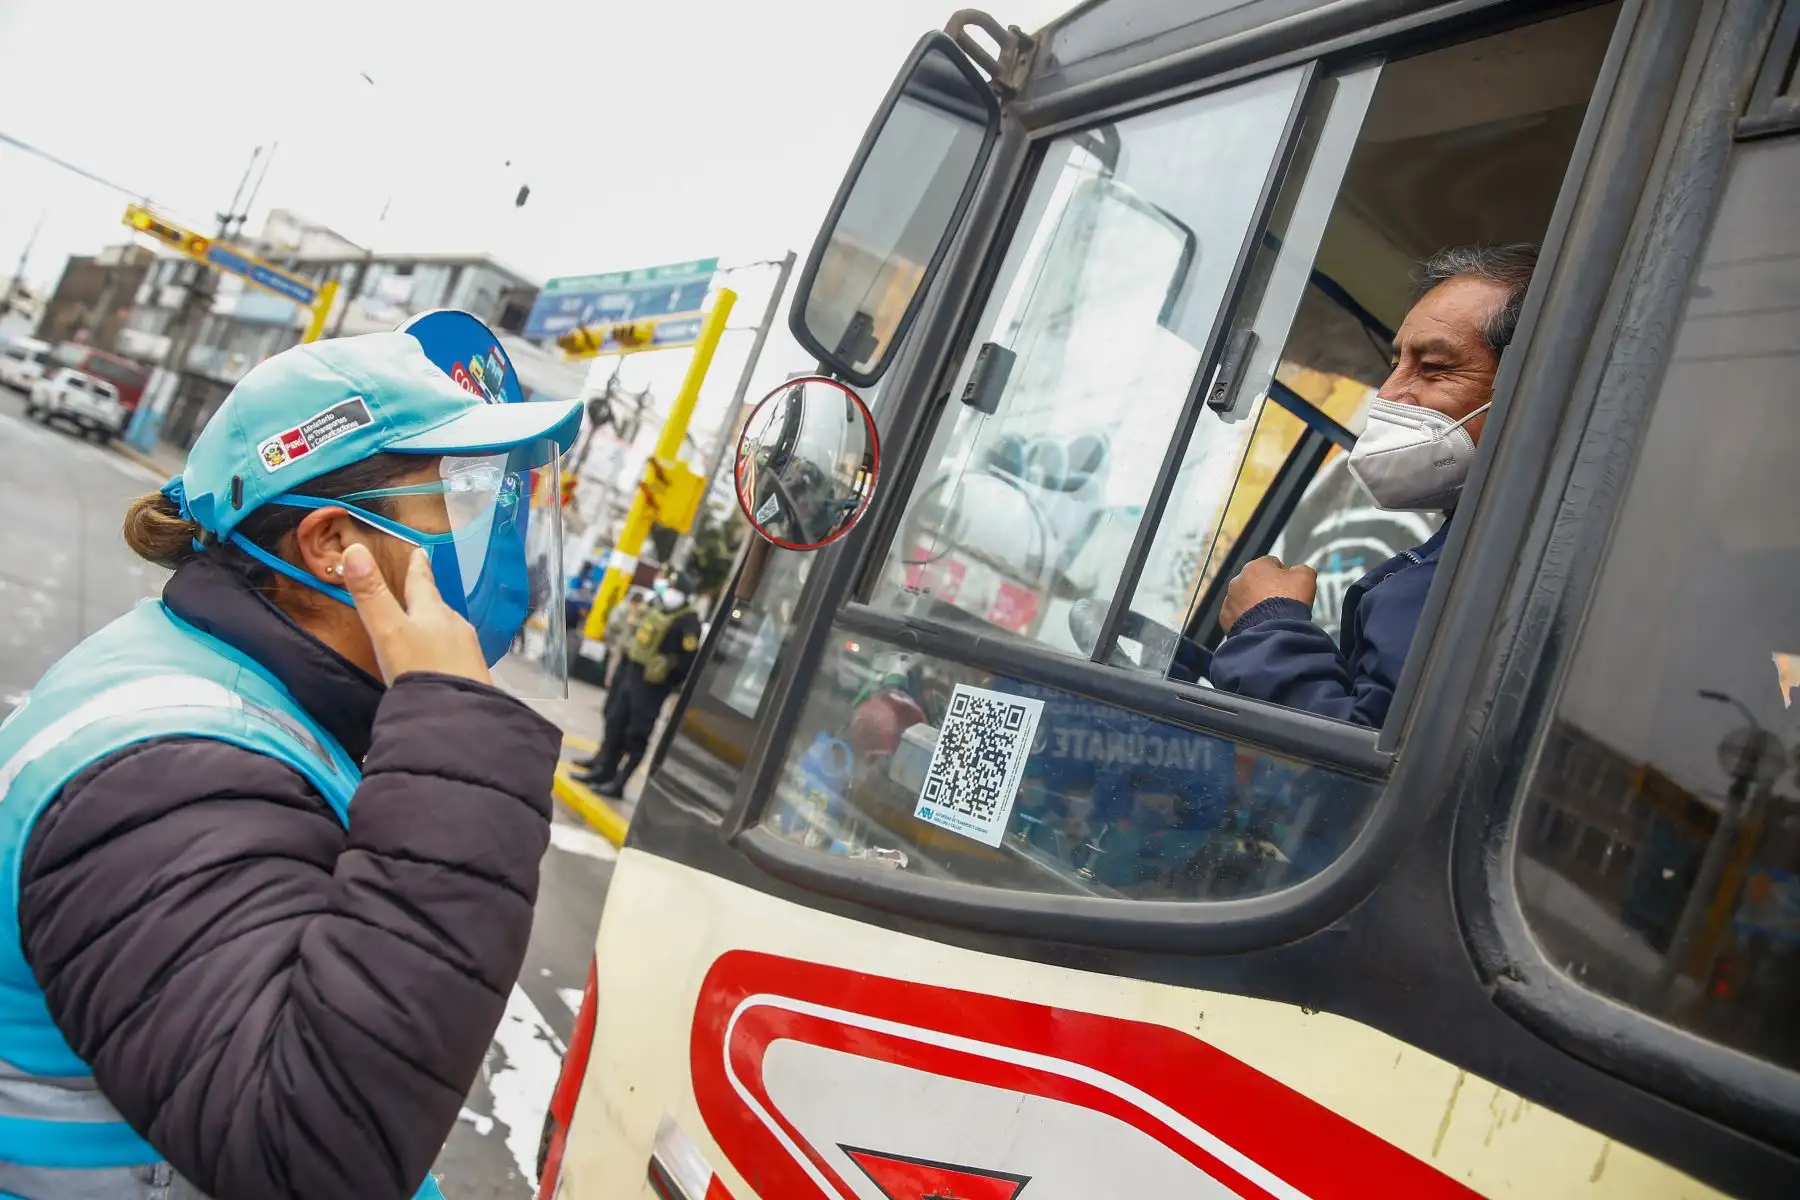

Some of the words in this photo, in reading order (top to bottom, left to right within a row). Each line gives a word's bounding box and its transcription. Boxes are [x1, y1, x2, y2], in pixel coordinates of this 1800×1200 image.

[303, 413, 335, 434] Ministerio
[307, 433, 316, 441] de
[315, 416, 348, 438] Transportes
[314, 421, 359, 445] Comunicaciones
[284, 437, 305, 451] PERÚ
